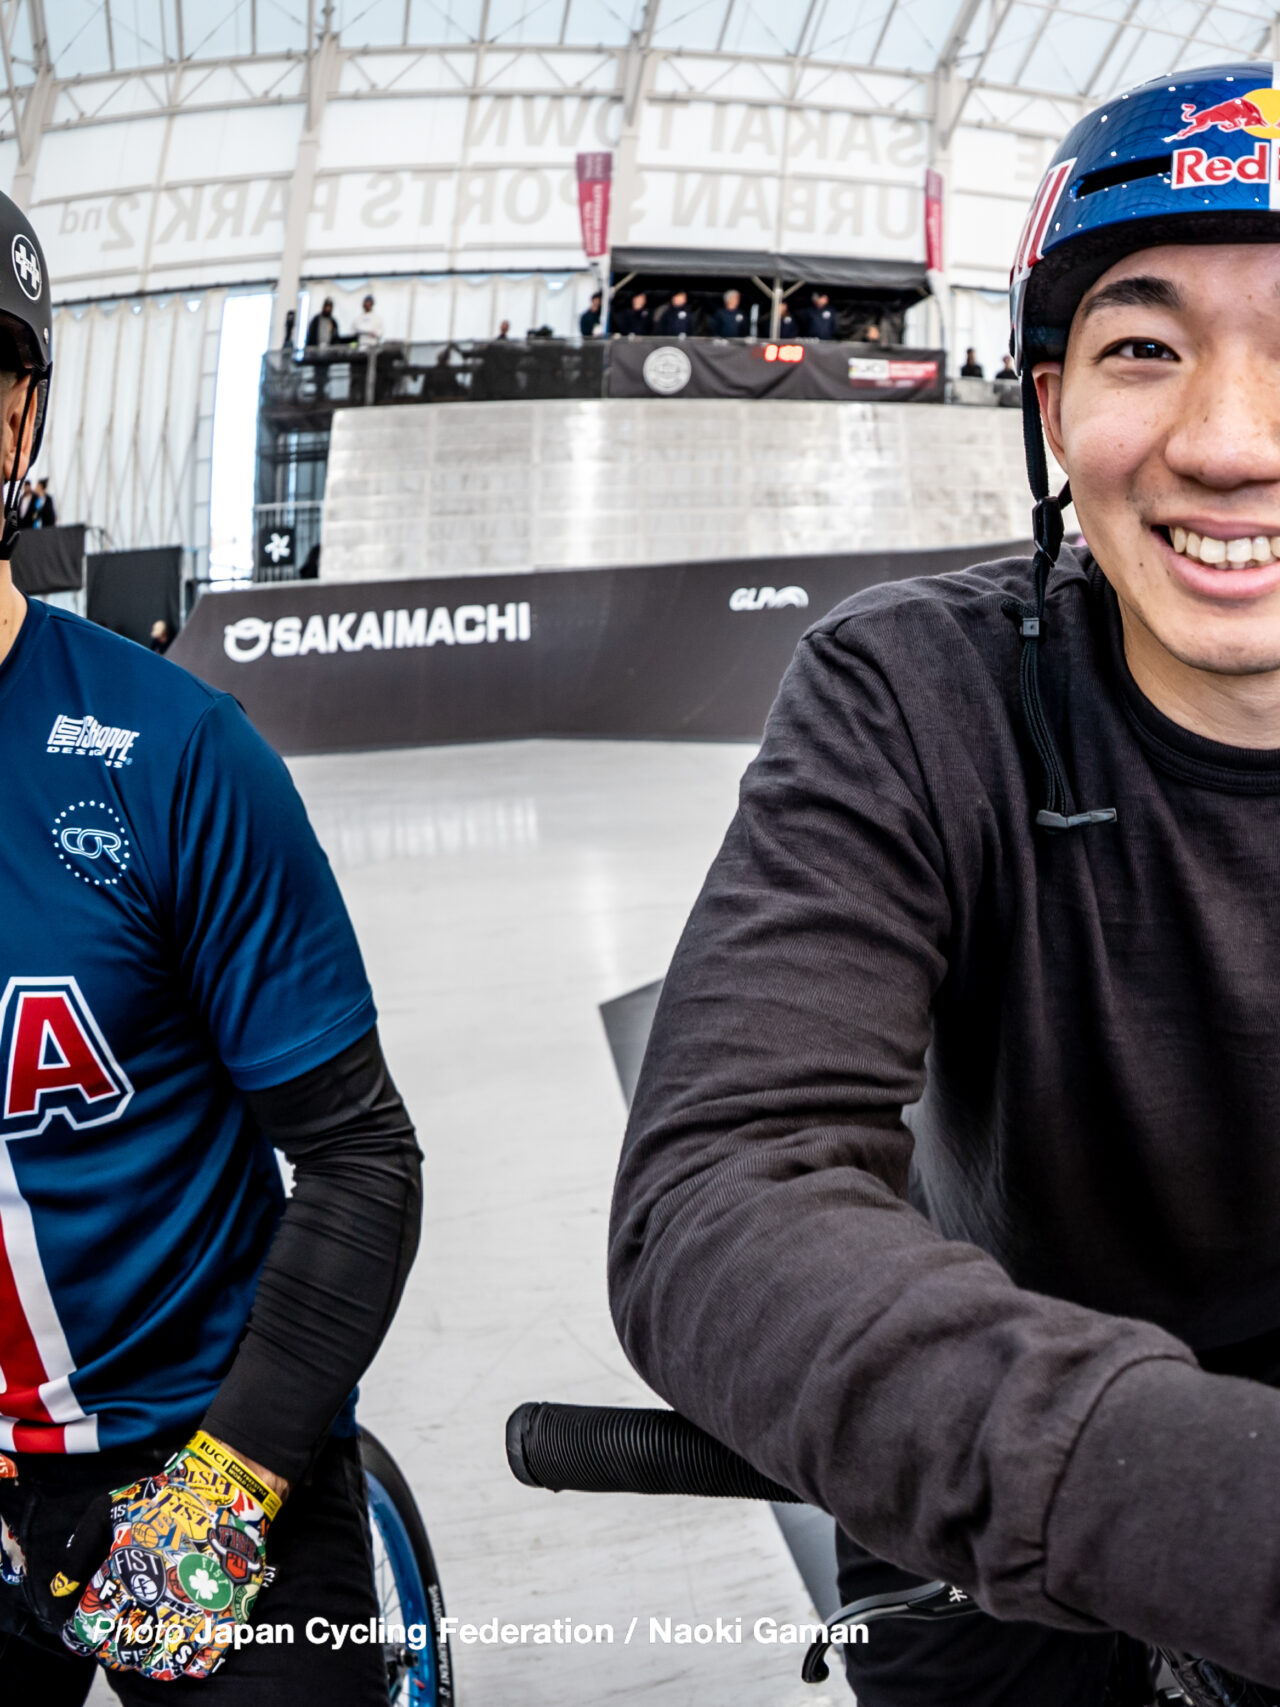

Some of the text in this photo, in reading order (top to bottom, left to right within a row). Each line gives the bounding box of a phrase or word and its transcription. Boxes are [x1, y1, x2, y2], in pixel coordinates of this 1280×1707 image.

[1174, 143, 1269, 188] Red
[271, 601, 531, 657] SAKAIMACHI
[203, 1444, 229, 1467] UCI
[114, 1549, 160, 1576] FIST
[201, 1556, 230, 1586] FIST
